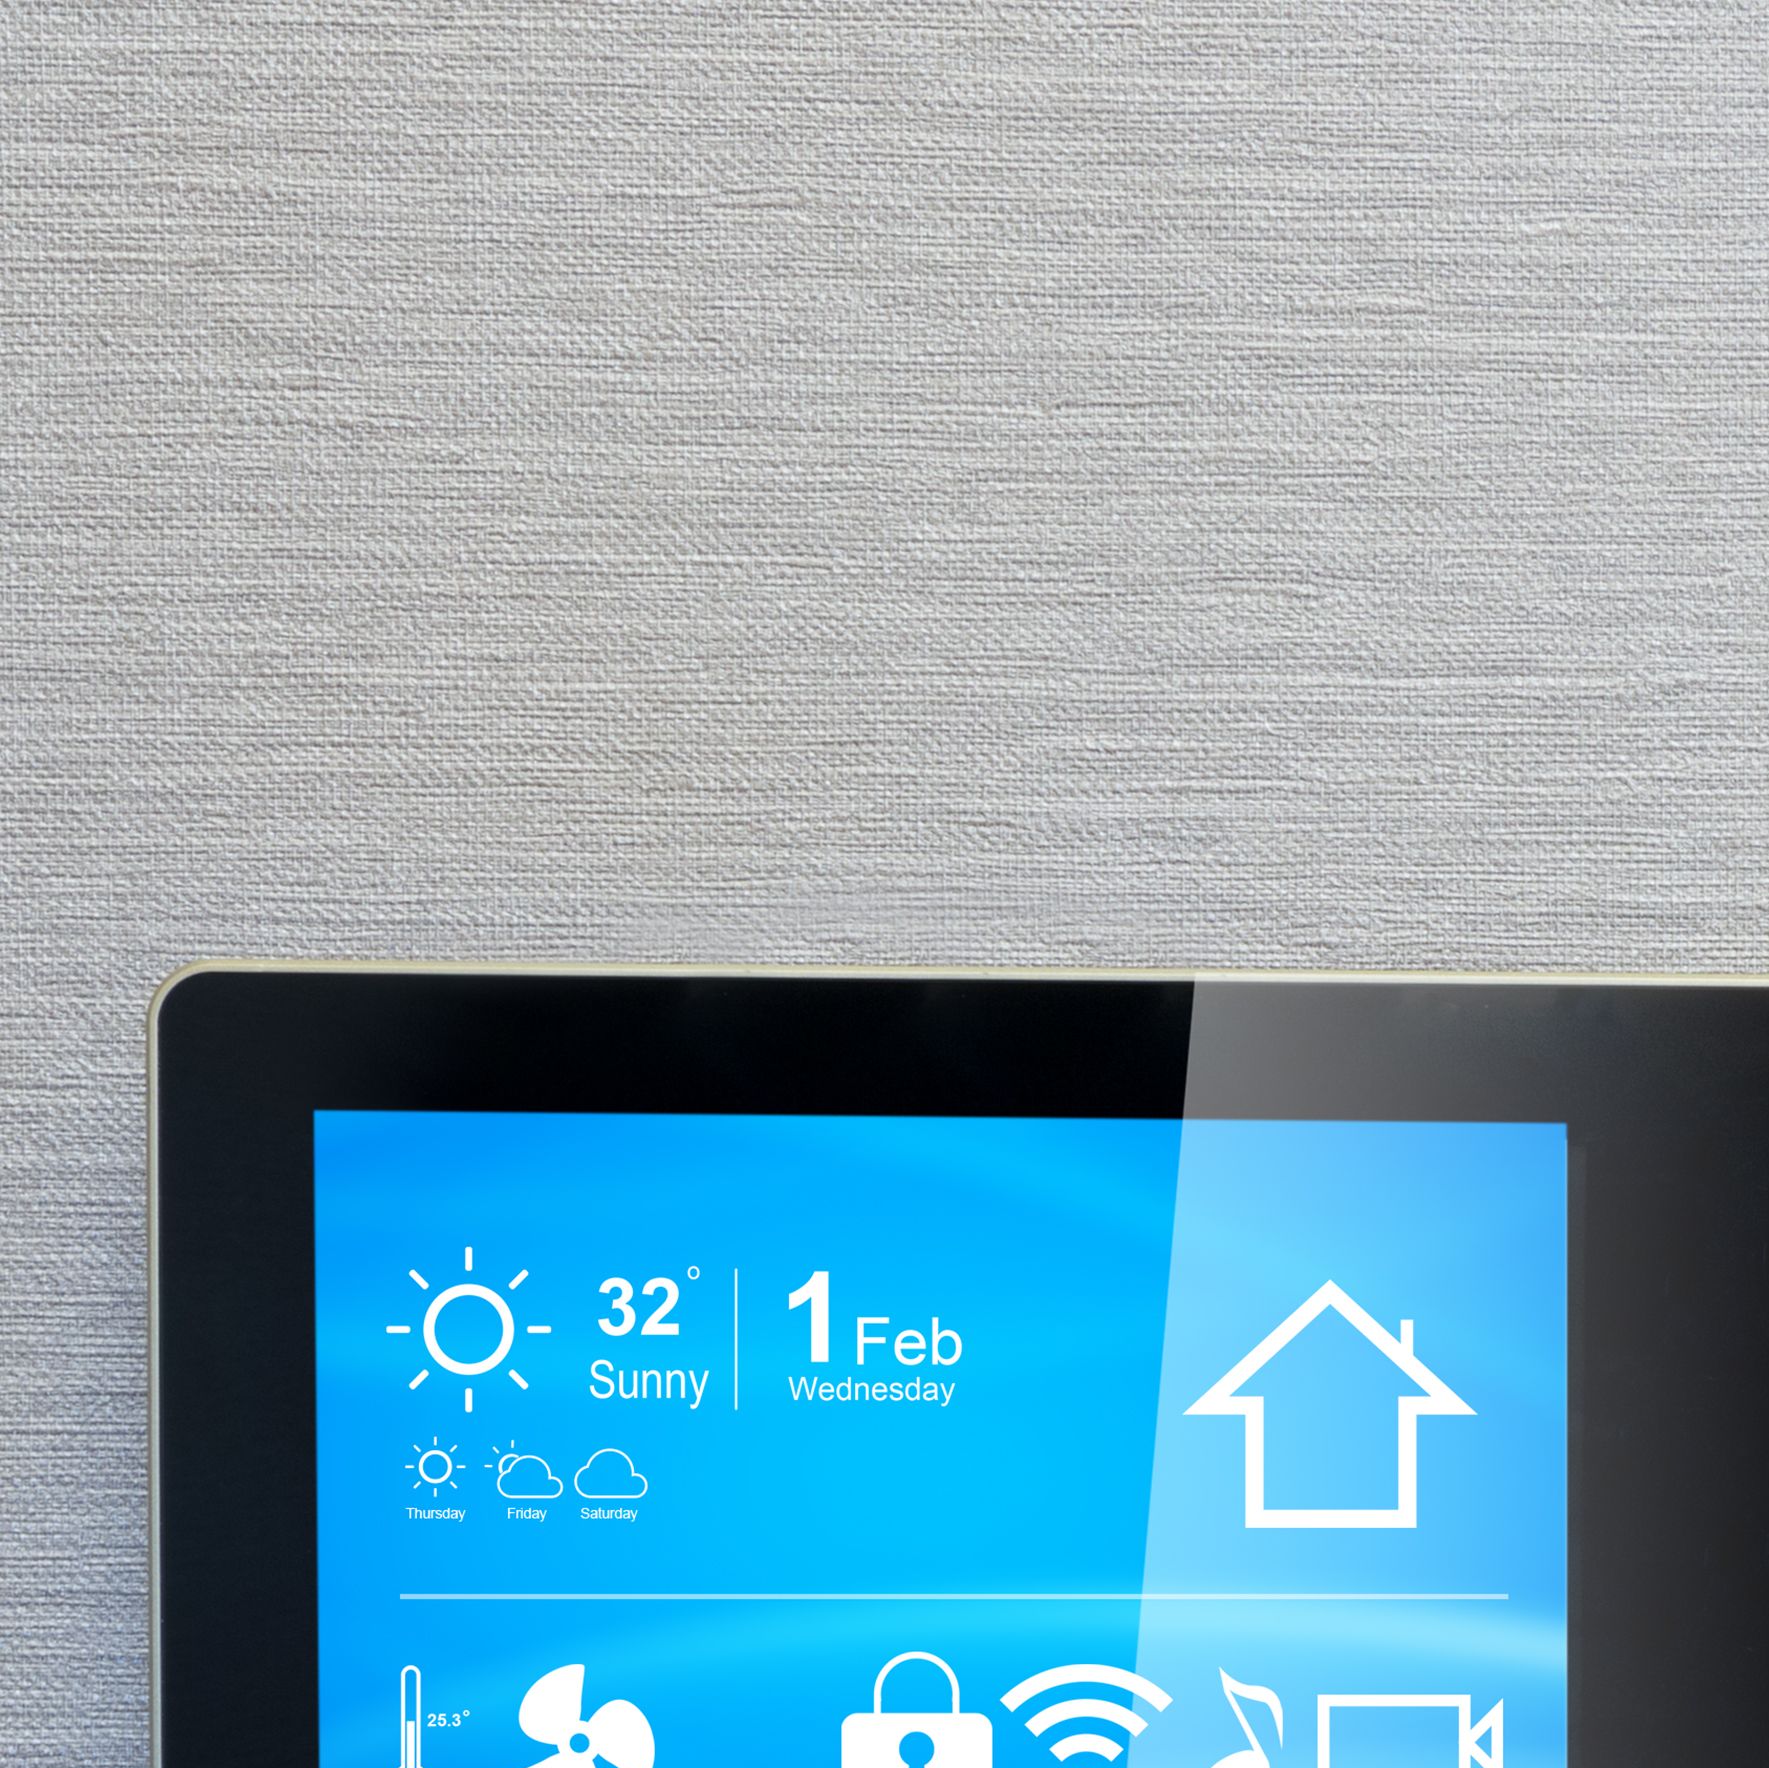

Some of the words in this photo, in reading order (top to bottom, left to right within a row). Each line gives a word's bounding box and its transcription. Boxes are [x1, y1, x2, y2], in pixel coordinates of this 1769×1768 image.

[788, 1271, 830, 1363] 1
[856, 1317, 963, 1366] Feb
[589, 1359, 709, 1410] Sunny
[788, 1376, 955, 1407] Wednesday
[406, 1507, 466, 1522] Thursday
[507, 1507, 547, 1522] Friday
[580, 1507, 638, 1522] Saturday
